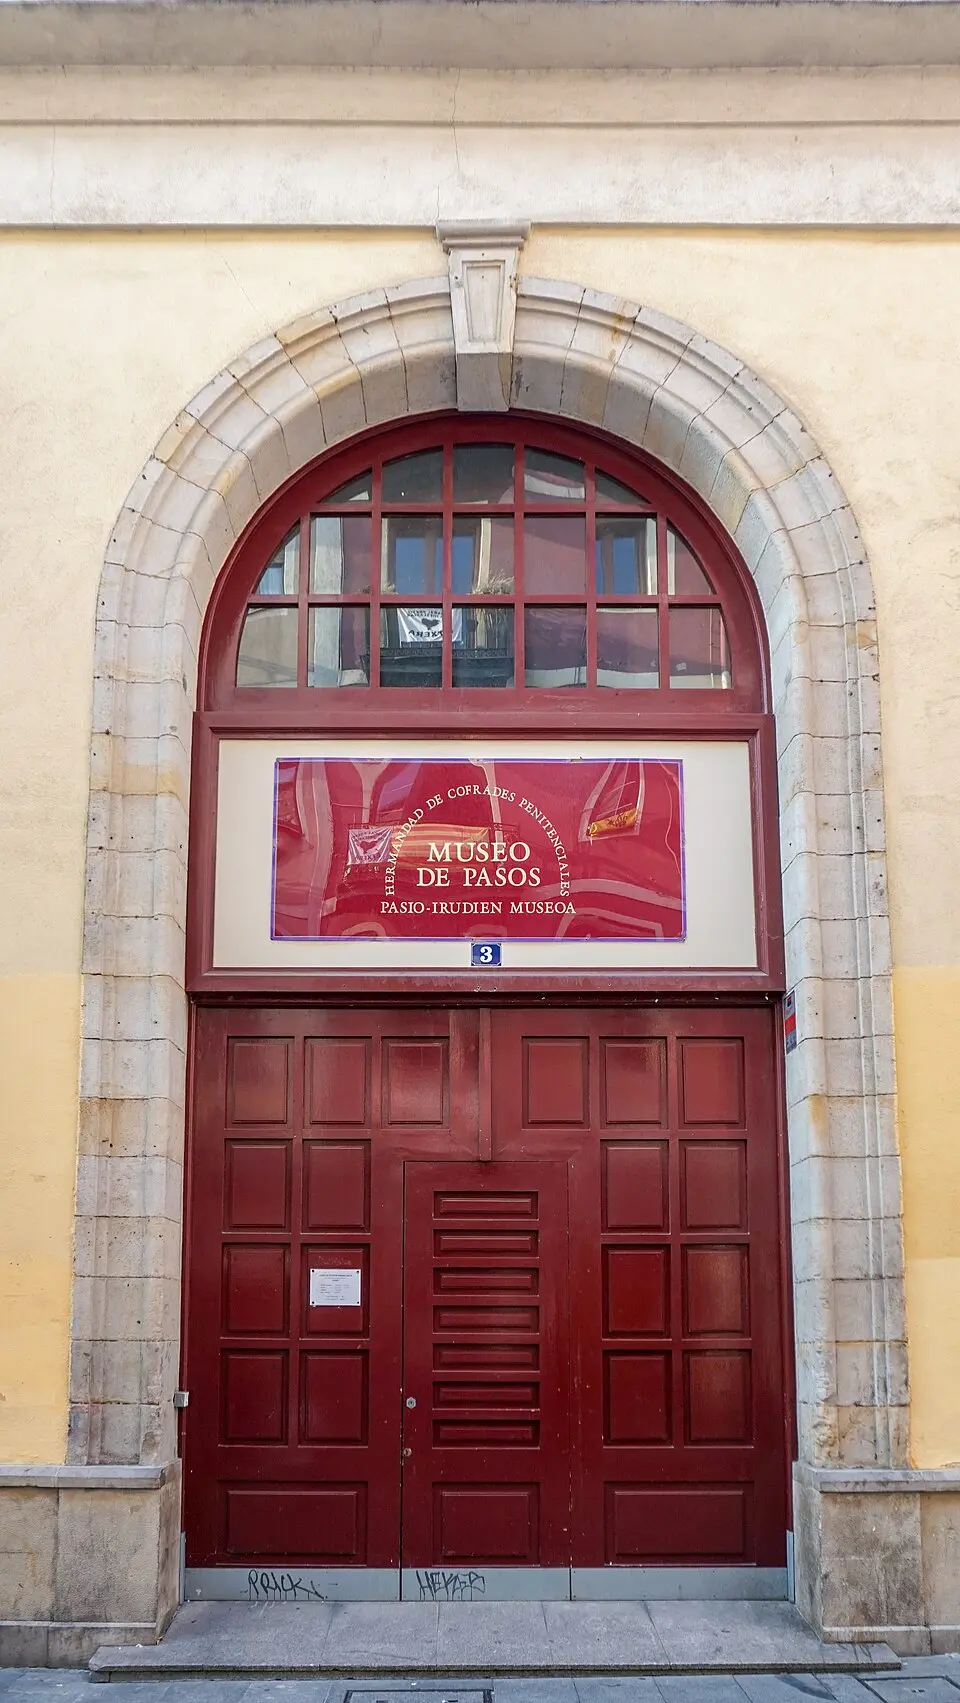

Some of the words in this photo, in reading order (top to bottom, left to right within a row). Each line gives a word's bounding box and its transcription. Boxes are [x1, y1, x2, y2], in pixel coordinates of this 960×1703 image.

[385, 808, 424, 896] HERMANDAD
[426, 794, 444, 810] DE
[447, 785, 516, 802] COFRADES
[518, 798, 570, 897] PENITENCIALES
[427, 841, 531, 862] MUSEO
[416, 867, 450, 887] DE
[463, 867, 541, 887] PASOS
[380, 901, 503, 914] PASIO-IRUDIEN
[509, 901, 577, 914] MUSEOA
[480, 946, 493, 963] 3
